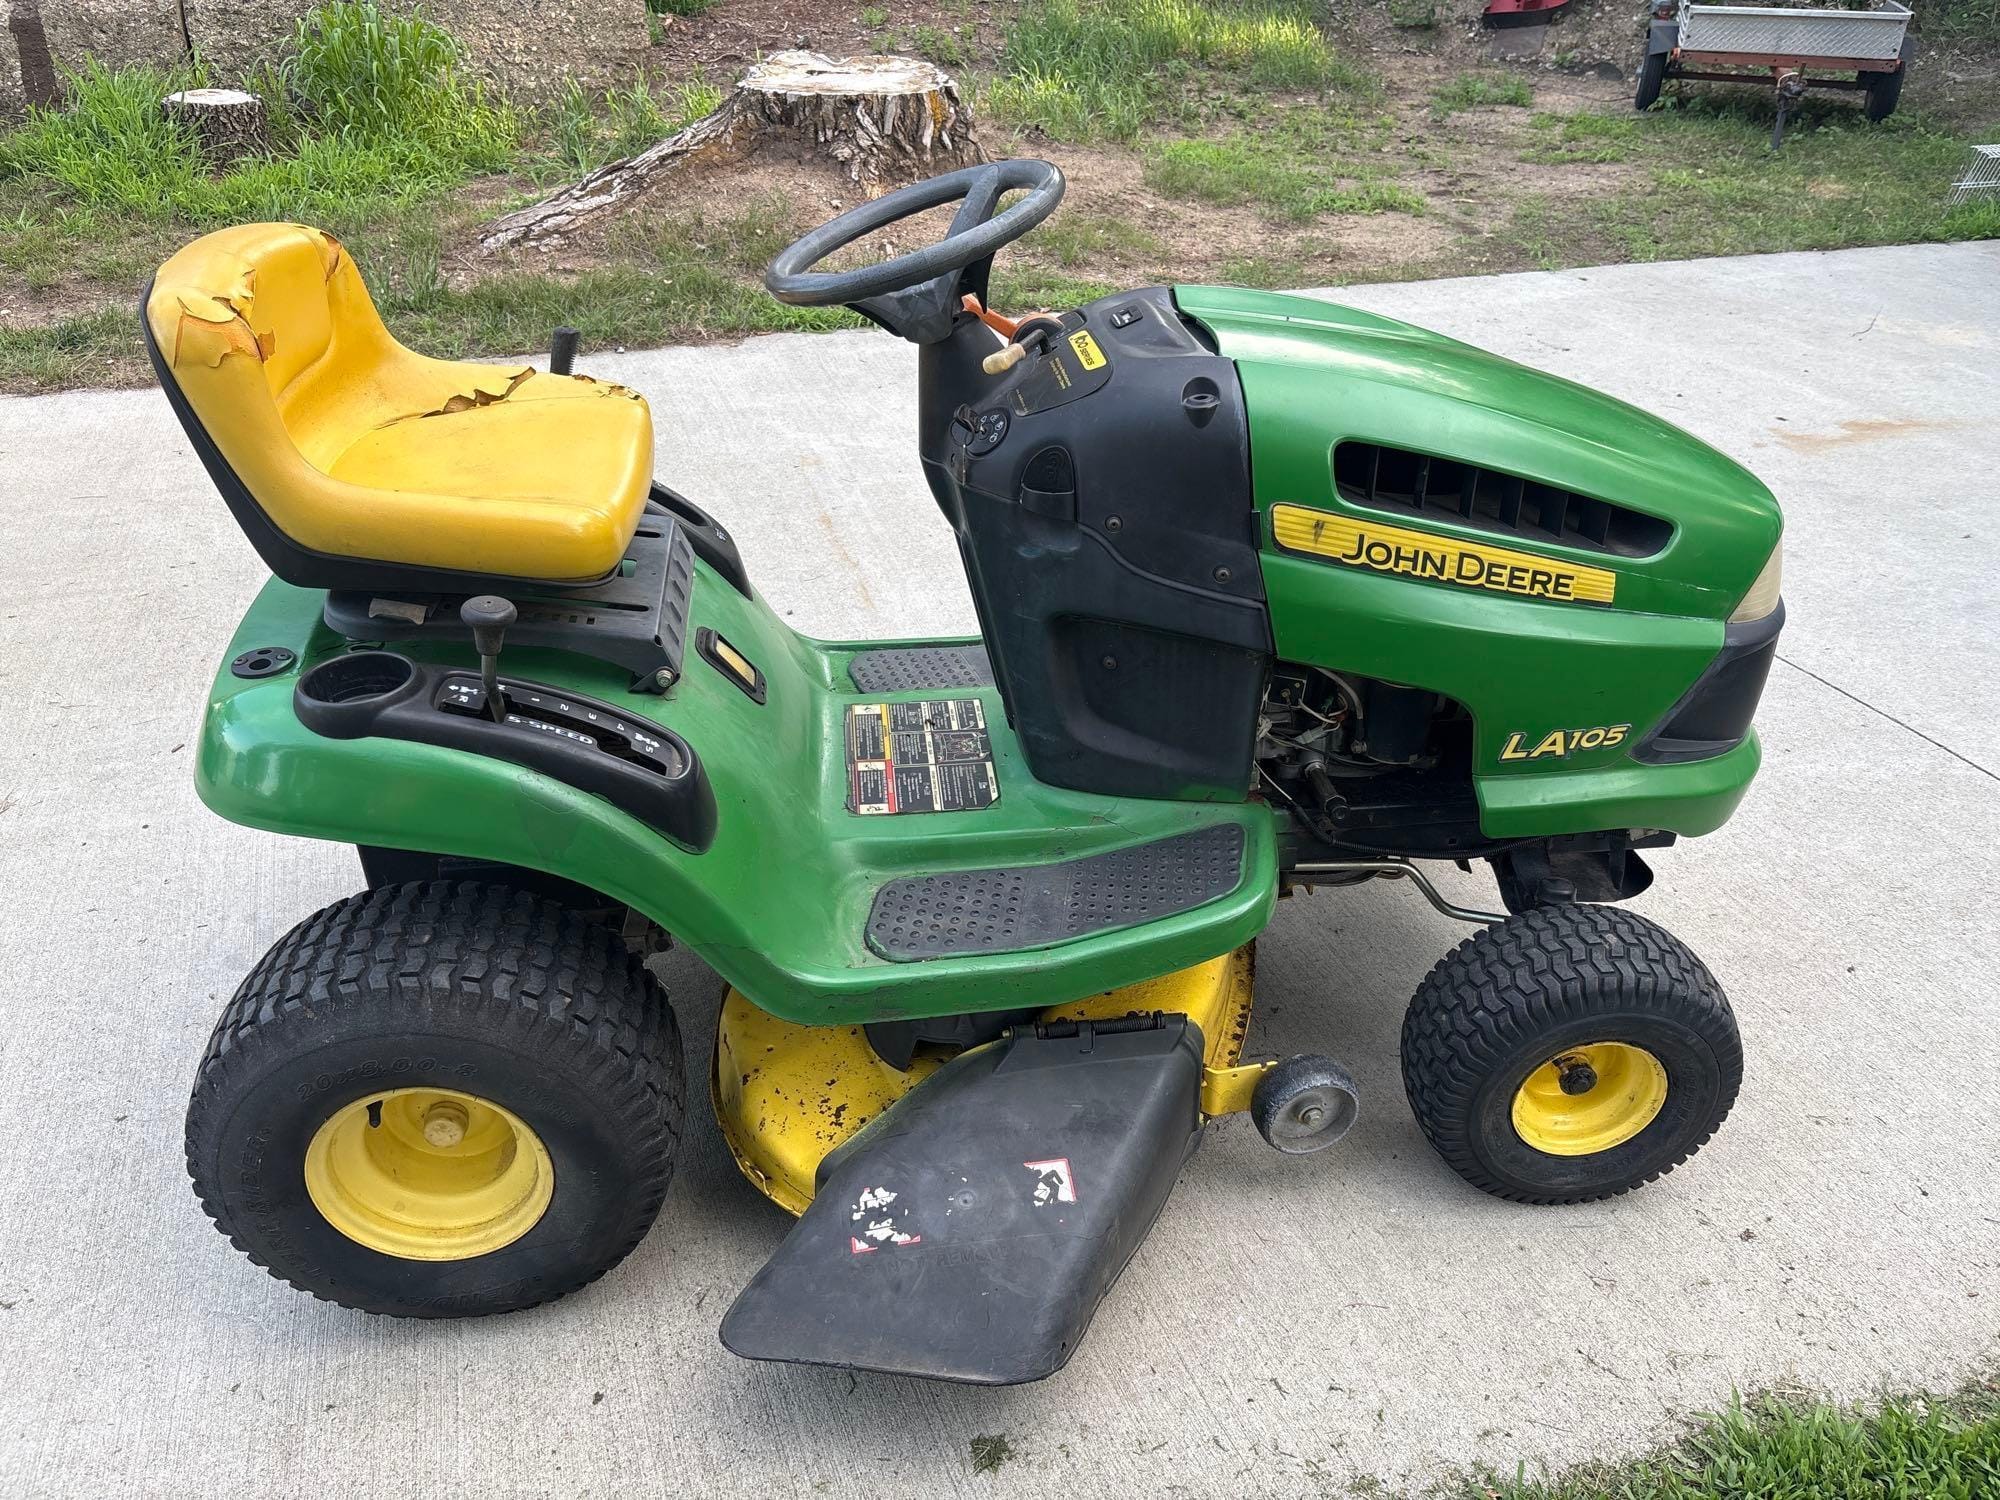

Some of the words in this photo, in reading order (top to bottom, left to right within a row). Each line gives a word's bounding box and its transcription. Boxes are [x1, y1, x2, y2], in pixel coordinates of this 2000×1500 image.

[1079, 347, 1095, 366] SERIES
[1342, 533, 1447, 579] JOHN
[1455, 552, 1575, 598] DEERE
[588, 712, 597, 720] 3
[616, 723, 625, 731] 4
[645, 745, 654, 753] 5
[1500, 724, 1631, 763] LA105
